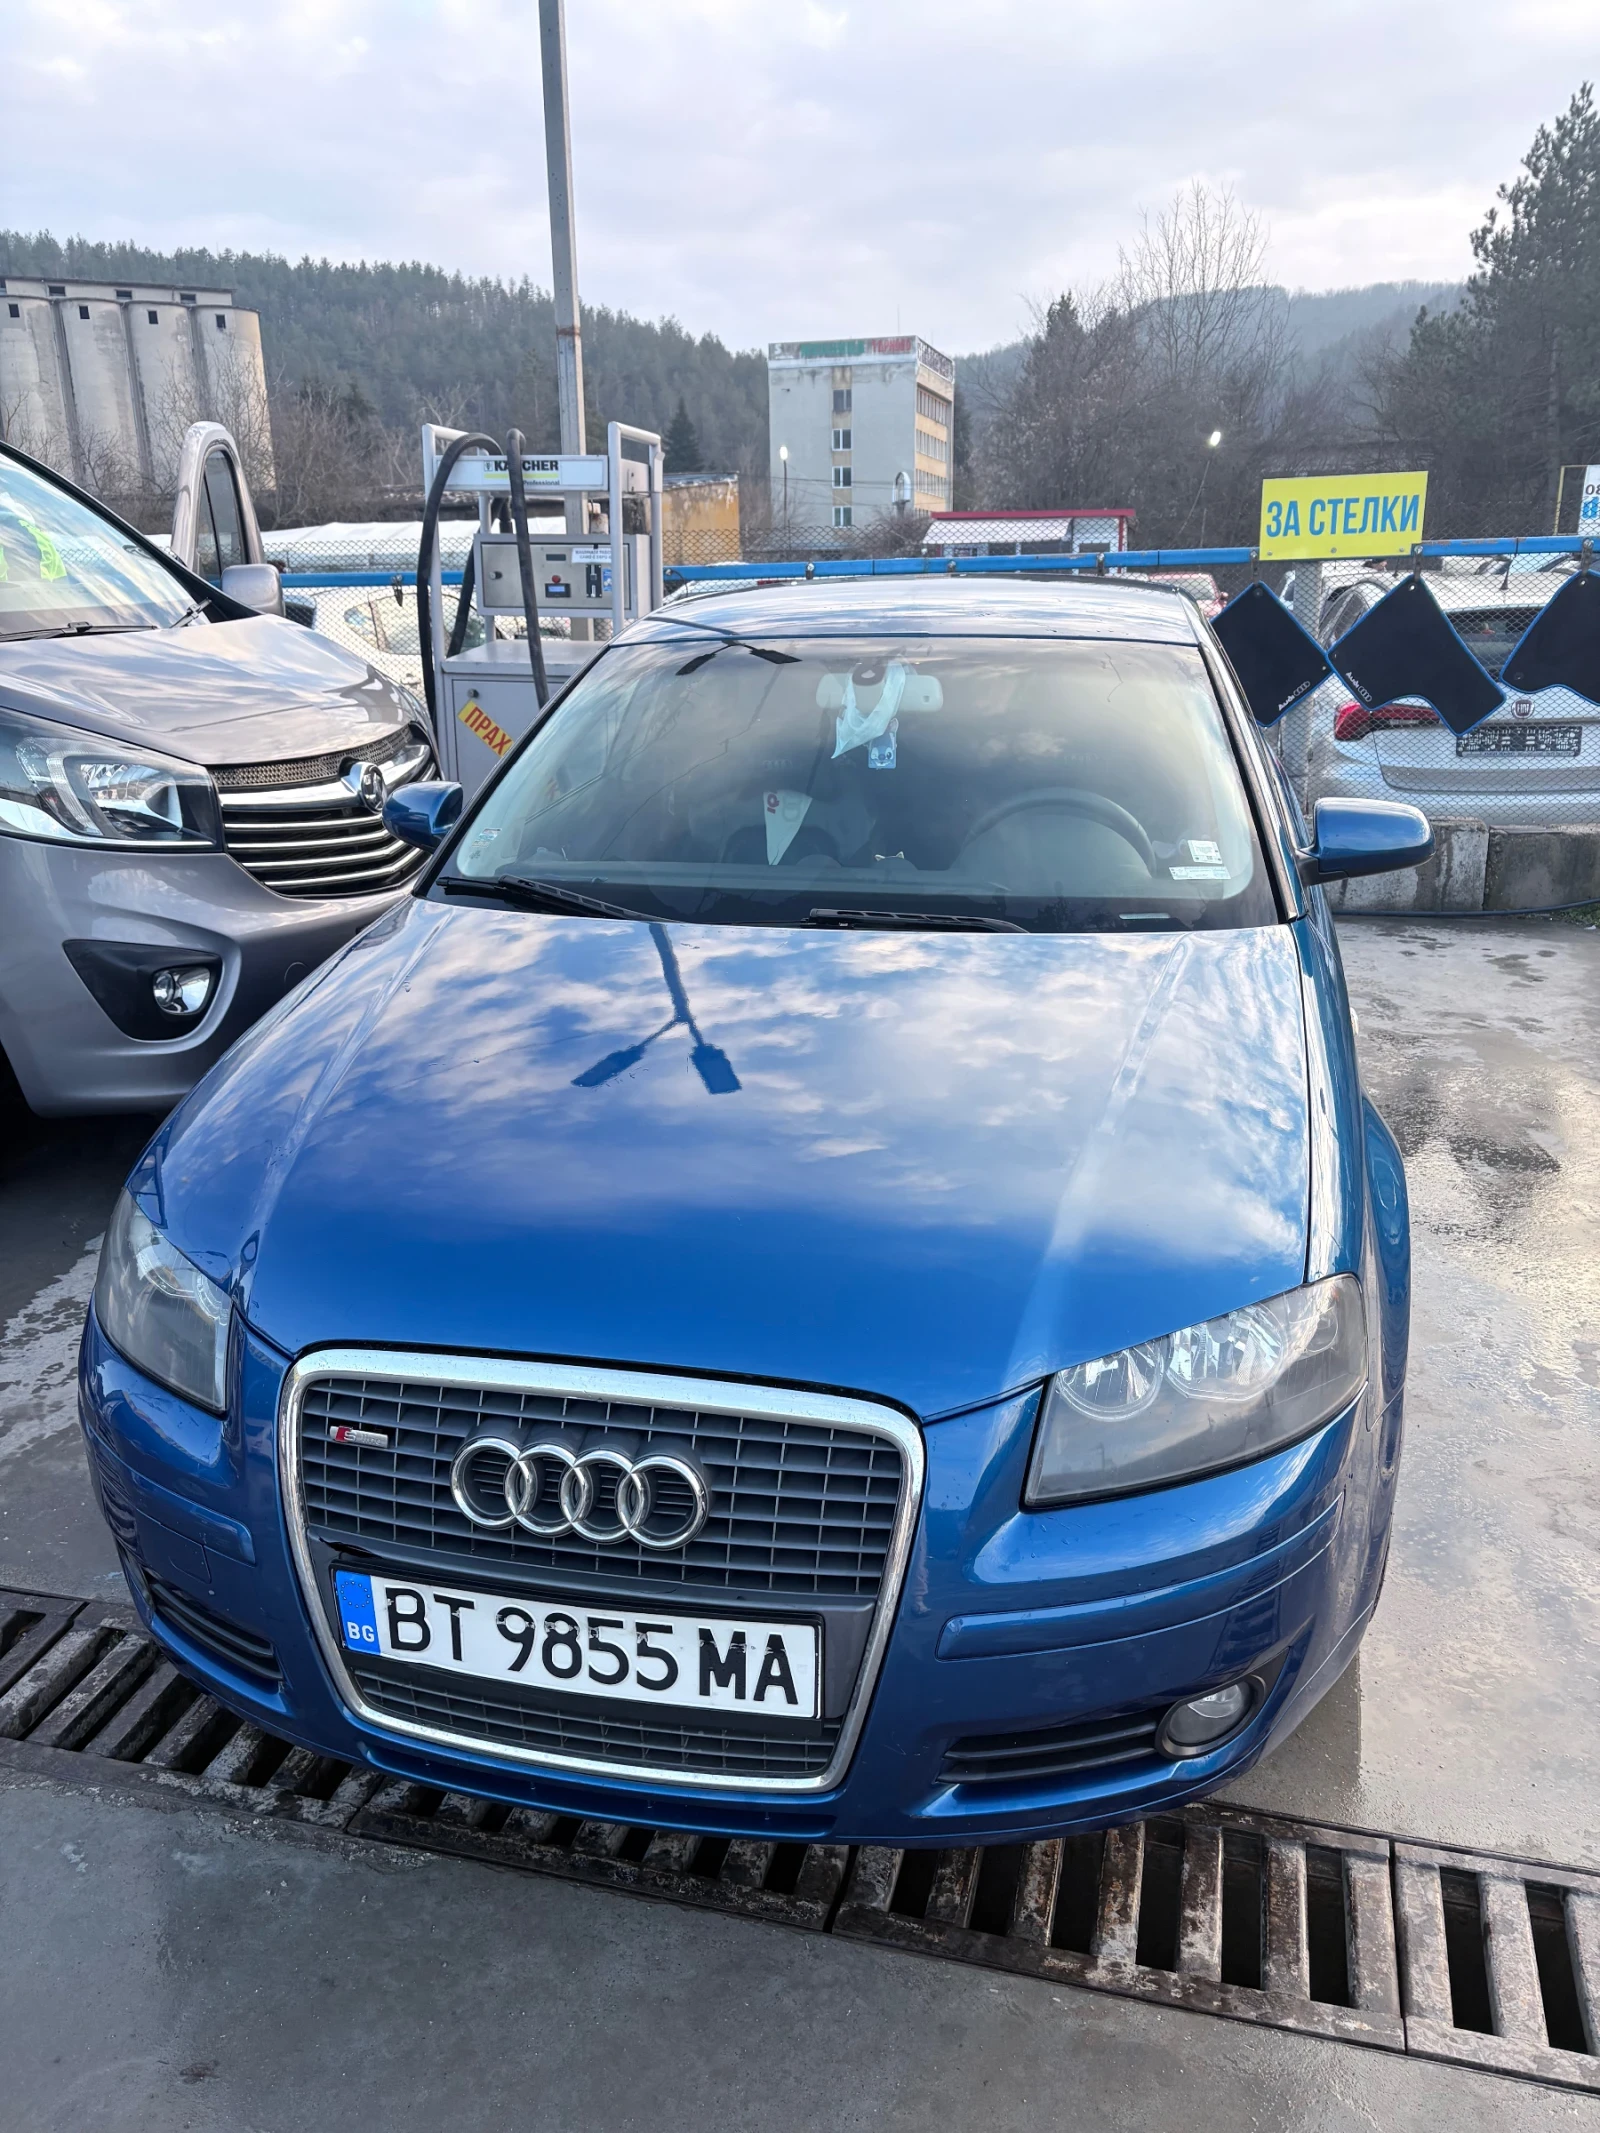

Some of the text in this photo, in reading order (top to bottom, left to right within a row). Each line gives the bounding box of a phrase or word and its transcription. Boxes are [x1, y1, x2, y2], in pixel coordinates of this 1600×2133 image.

[494, 460, 559, 472] KCHER
[1266, 494, 1420, 537] ЗА СТЕЛКИ
[1278, 694, 1295, 711] Audi
[464, 706, 512, 756] ПРАХ
[346, 1621, 376, 1643] BG
[384, 1586, 799, 1705] BT 9855 MA
